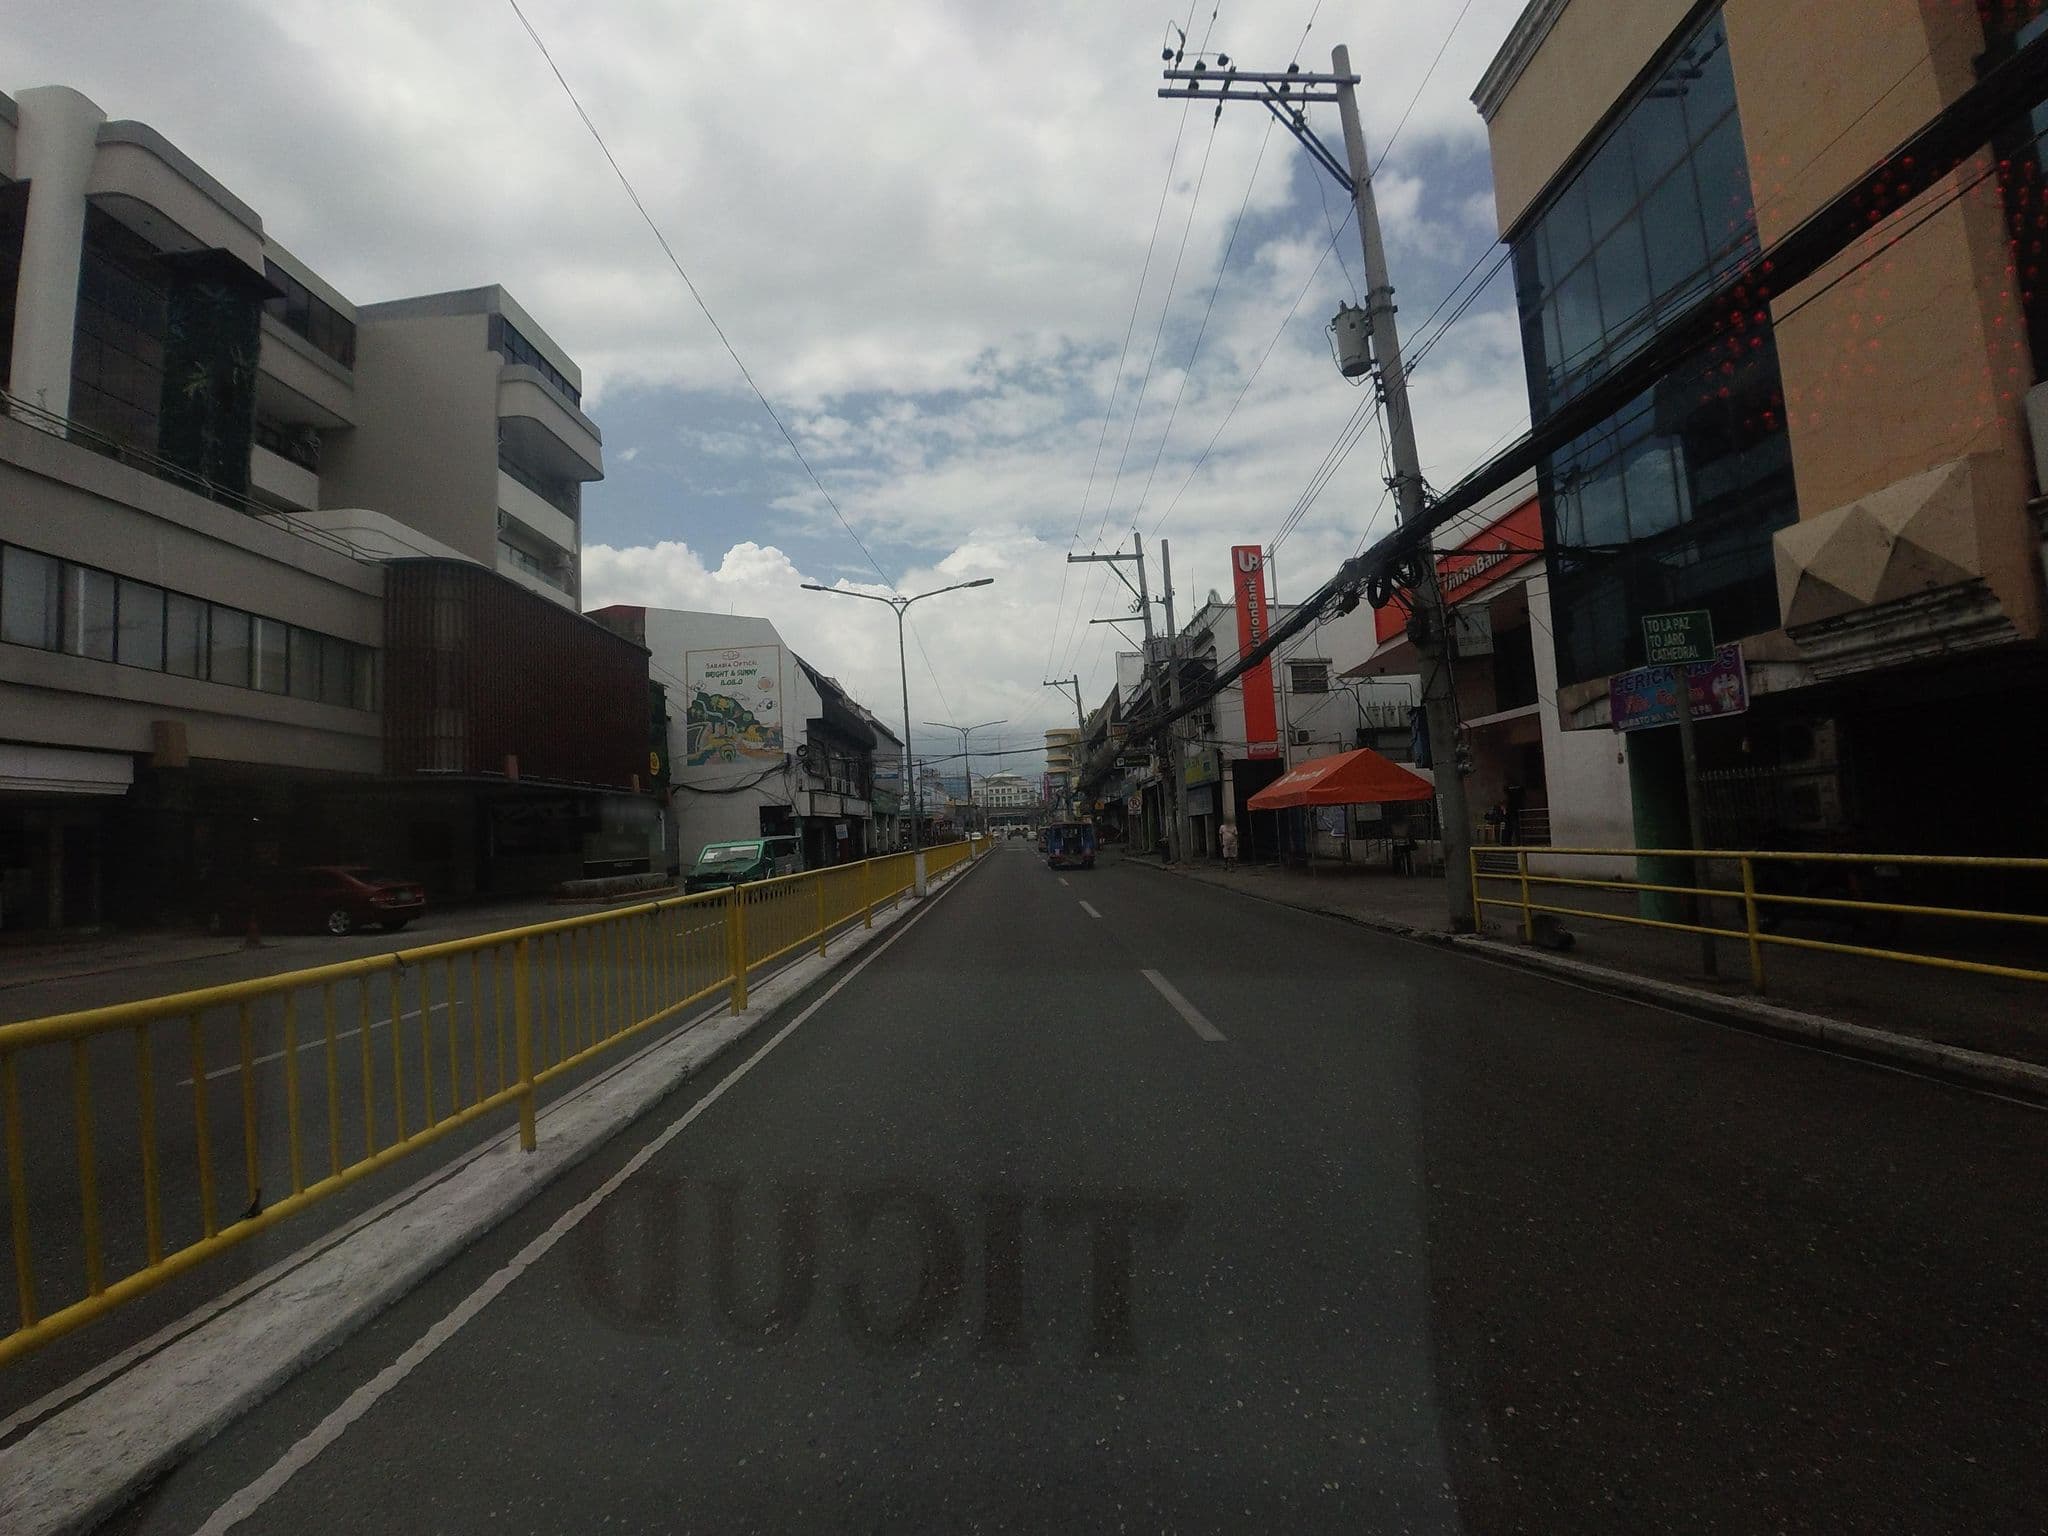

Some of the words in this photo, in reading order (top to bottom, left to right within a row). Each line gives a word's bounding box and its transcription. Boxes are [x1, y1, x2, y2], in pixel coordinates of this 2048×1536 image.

[1440, 542, 1509, 592] UnionBank
[1247, 577, 1262, 647] UnionBank
[1647, 620, 1660, 632] TO
[1660, 618, 1673, 631] LA
[1673, 616, 1692, 630] PAZ
[1648, 634, 1662, 648] TO
[1663, 633, 1685, 647] JARO
[1652, 643, 1699, 661] CATHEDRAL
[737, 668, 758, 676] SUNNY
